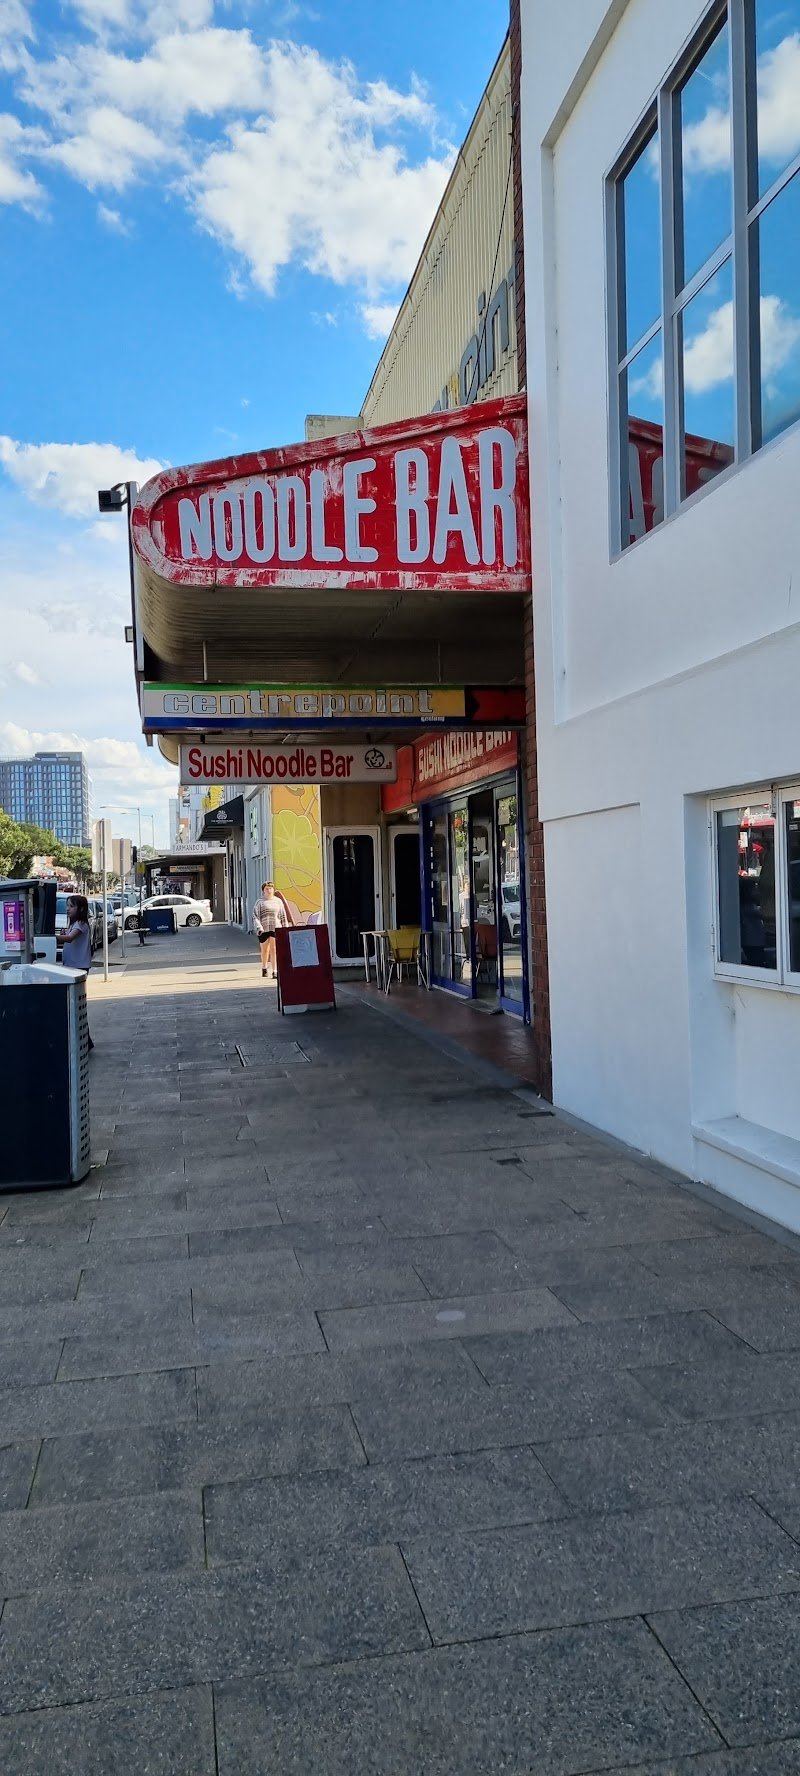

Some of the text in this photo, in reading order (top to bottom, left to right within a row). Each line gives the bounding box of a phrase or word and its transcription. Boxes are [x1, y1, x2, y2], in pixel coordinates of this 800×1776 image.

[177, 457, 379, 564] NOODLE
[394, 426, 518, 568] BAR
[163, 689, 434, 718] centrepoint
[188, 748, 354, 778] Sushi Noodle Bar
[418, 738, 443, 782] SUSHI
